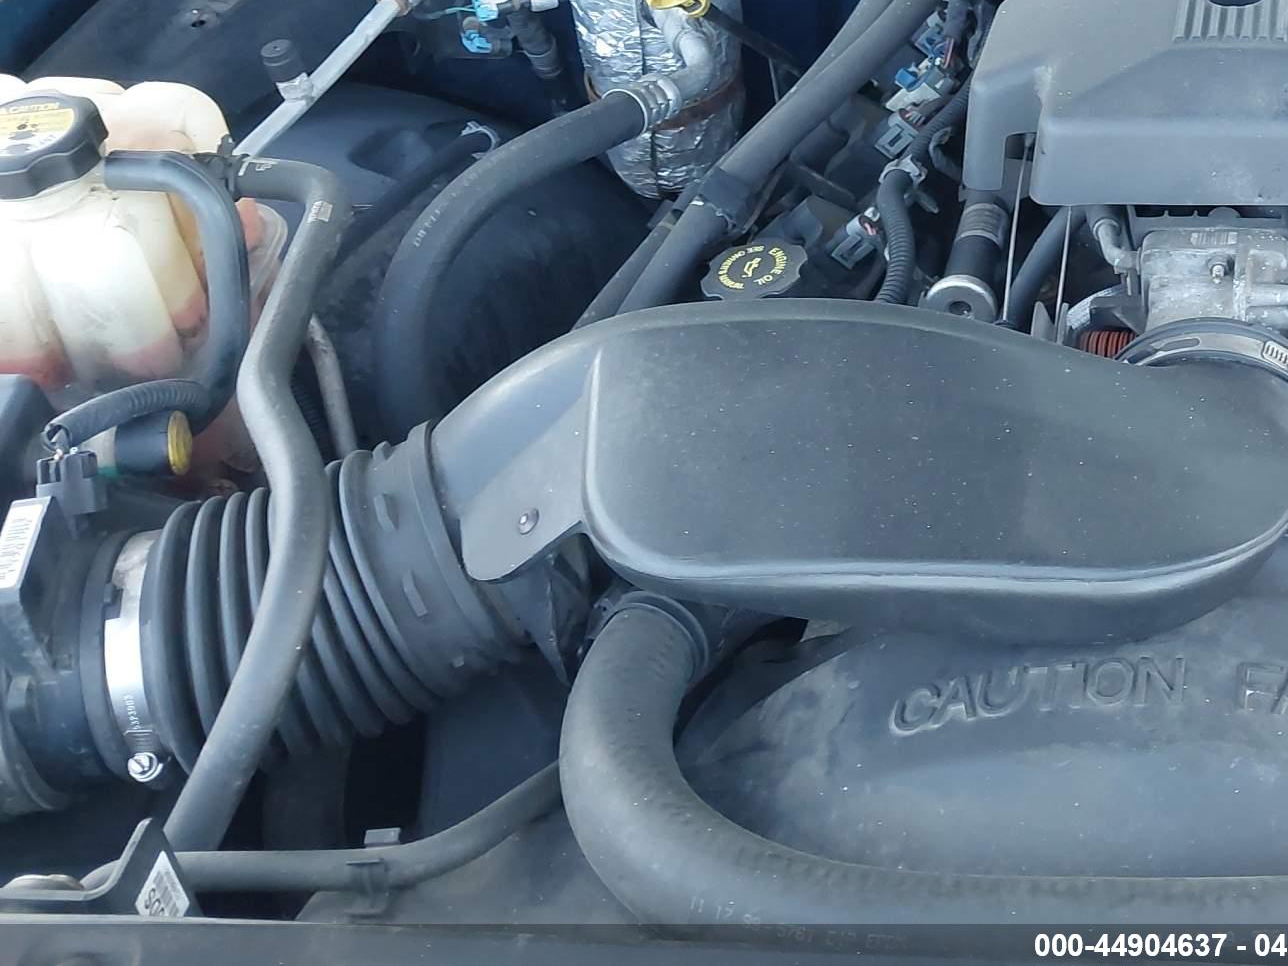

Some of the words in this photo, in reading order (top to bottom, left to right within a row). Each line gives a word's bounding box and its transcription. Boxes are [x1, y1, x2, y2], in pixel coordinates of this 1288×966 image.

[768, 247, 787, 274] ENGINE
[753, 275, 773, 285] OIL
[889, 656, 1186, 735] CAUTION
